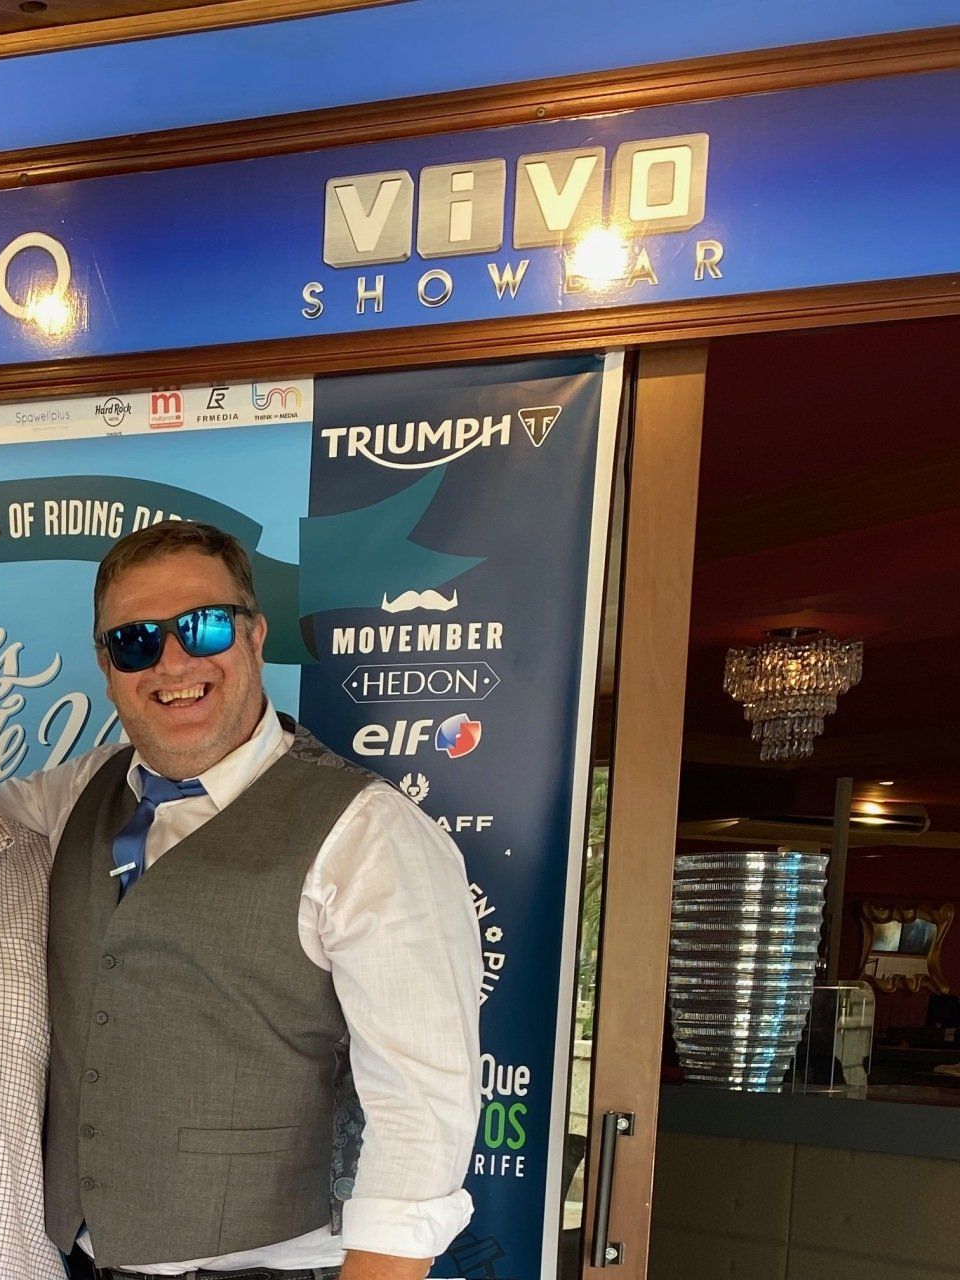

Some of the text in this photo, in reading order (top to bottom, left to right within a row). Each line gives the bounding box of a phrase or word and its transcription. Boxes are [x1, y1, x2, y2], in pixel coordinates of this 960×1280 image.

[95, 402, 132, 416] Hard Rock
[197, 413, 239, 422] FRMEDIA
[321, 415, 511, 469] TRIUMPH
[8, 502, 35, 538] OF
[44, 500, 125, 538] RIDING
[331, 622, 504, 655] MOVEMBER
[362, 669, 478, 696] HEDON
[352, 719, 434, 756] elf
[480, 1053, 531, 1100] Que
[474, 1153, 526, 1178] RIFE
